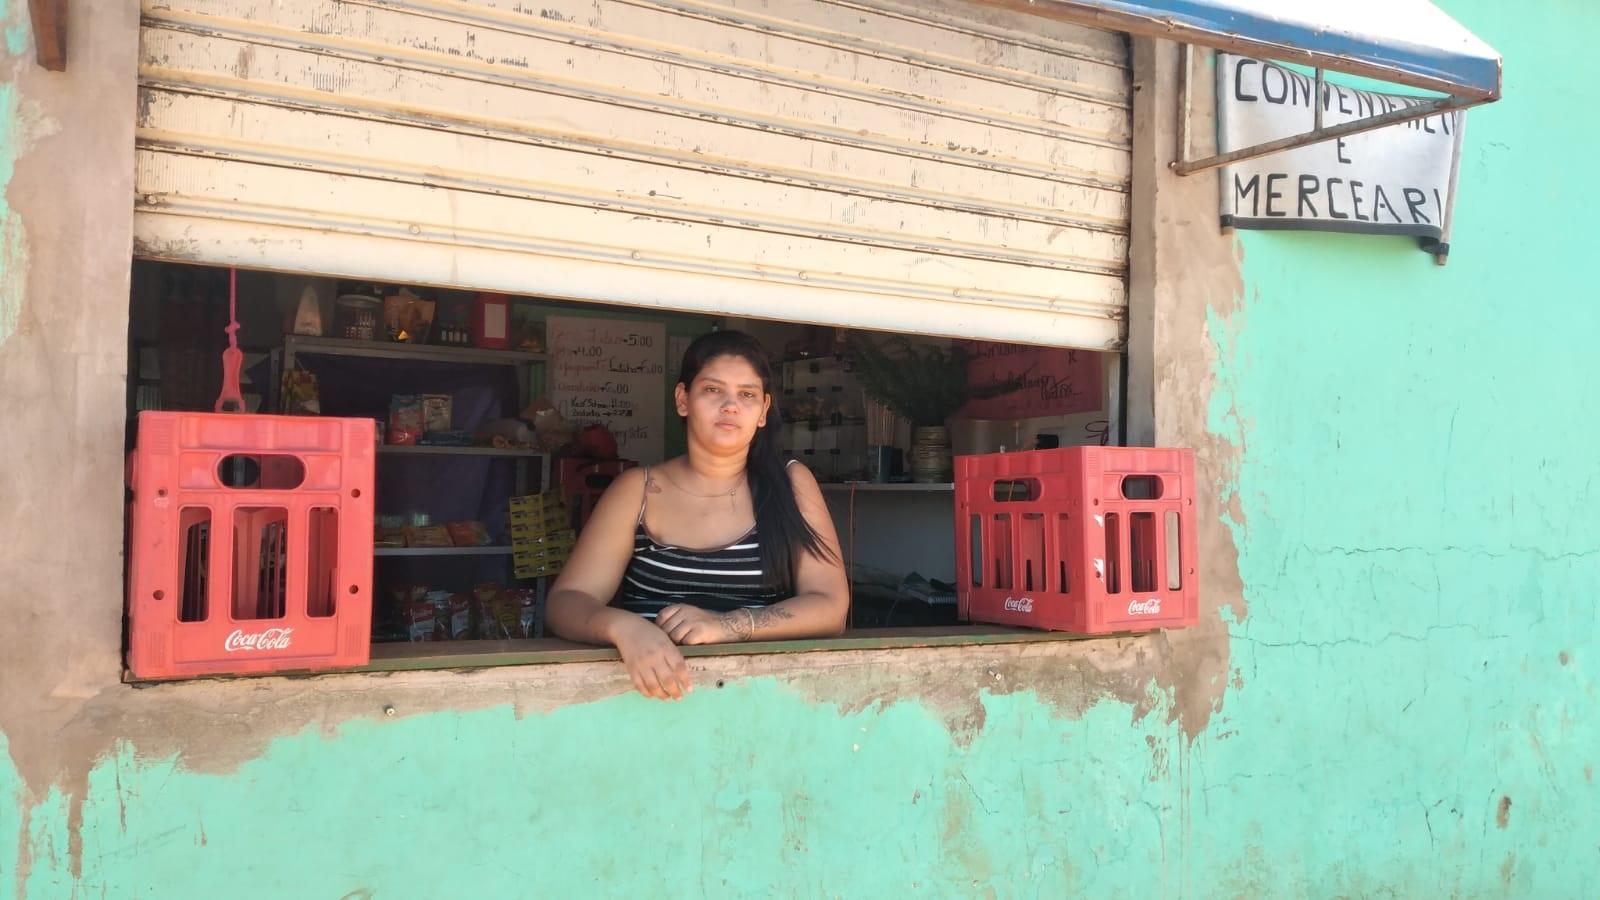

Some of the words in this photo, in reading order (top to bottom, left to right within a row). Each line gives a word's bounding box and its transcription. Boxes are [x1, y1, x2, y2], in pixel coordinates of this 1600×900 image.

[1336, 135, 1352, 164] E
[1234, 173, 1443, 227] MERCEARI
[1004, 596, 1034, 613] Coca-Cola
[1128, 598, 1162, 615] Coca-Cola
[224, 627, 294, 652] Coca-Cola
